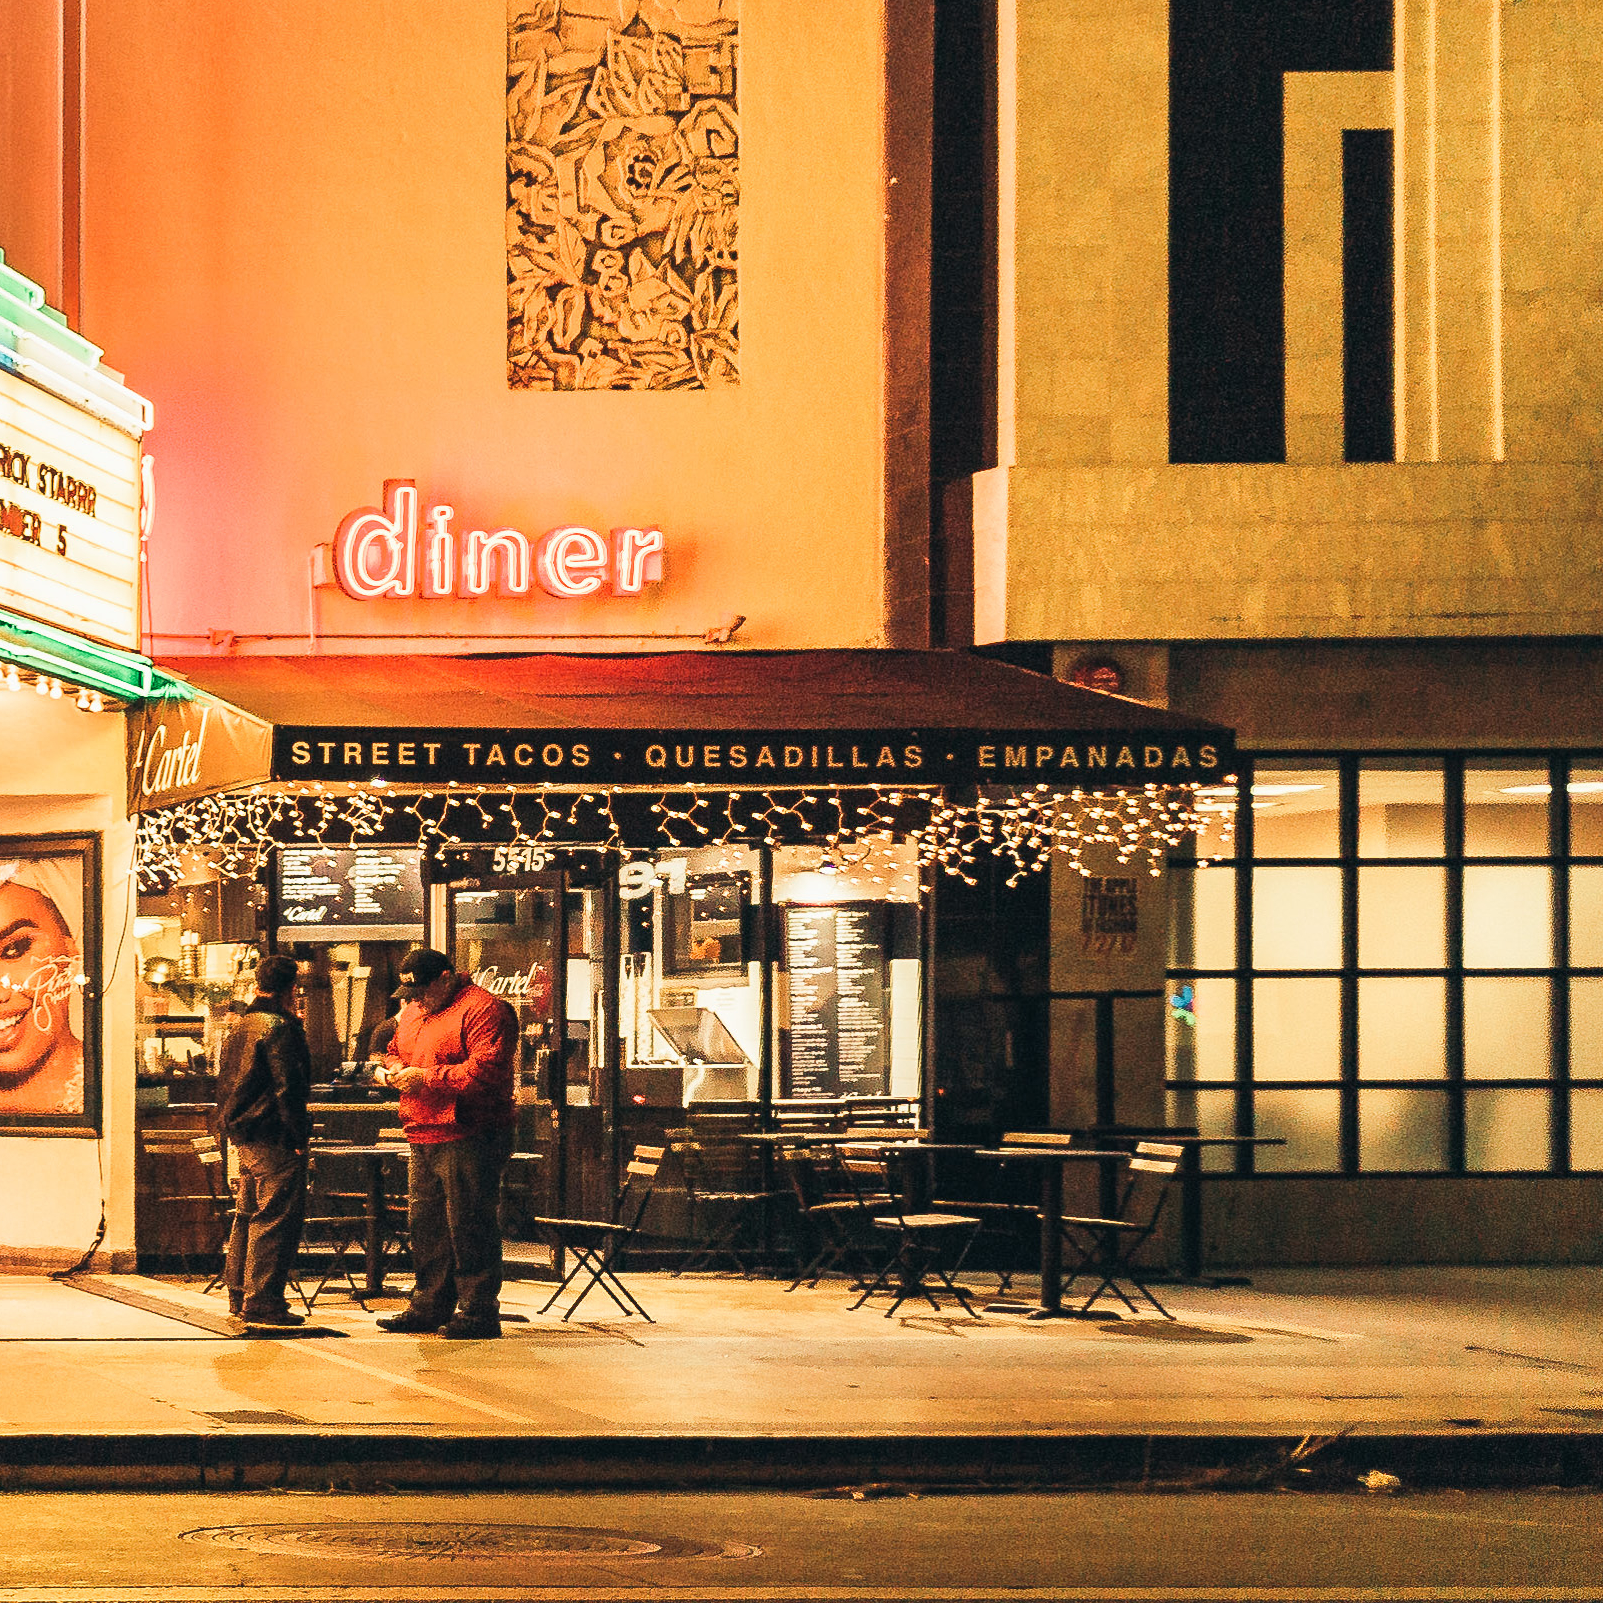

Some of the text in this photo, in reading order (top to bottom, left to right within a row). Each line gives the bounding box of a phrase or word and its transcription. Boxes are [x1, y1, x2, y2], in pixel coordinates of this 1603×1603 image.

[37, 462, 97, 519] STARRR
[57, 524, 67, 557] 5
[333, 479, 665, 601] diner
[141, 707, 211, 796] Cartel
[292, 741, 1221, 769] STREET TACOS QUESADILLAS EMPANADAS
[478, 962, 538, 995] Cartel
